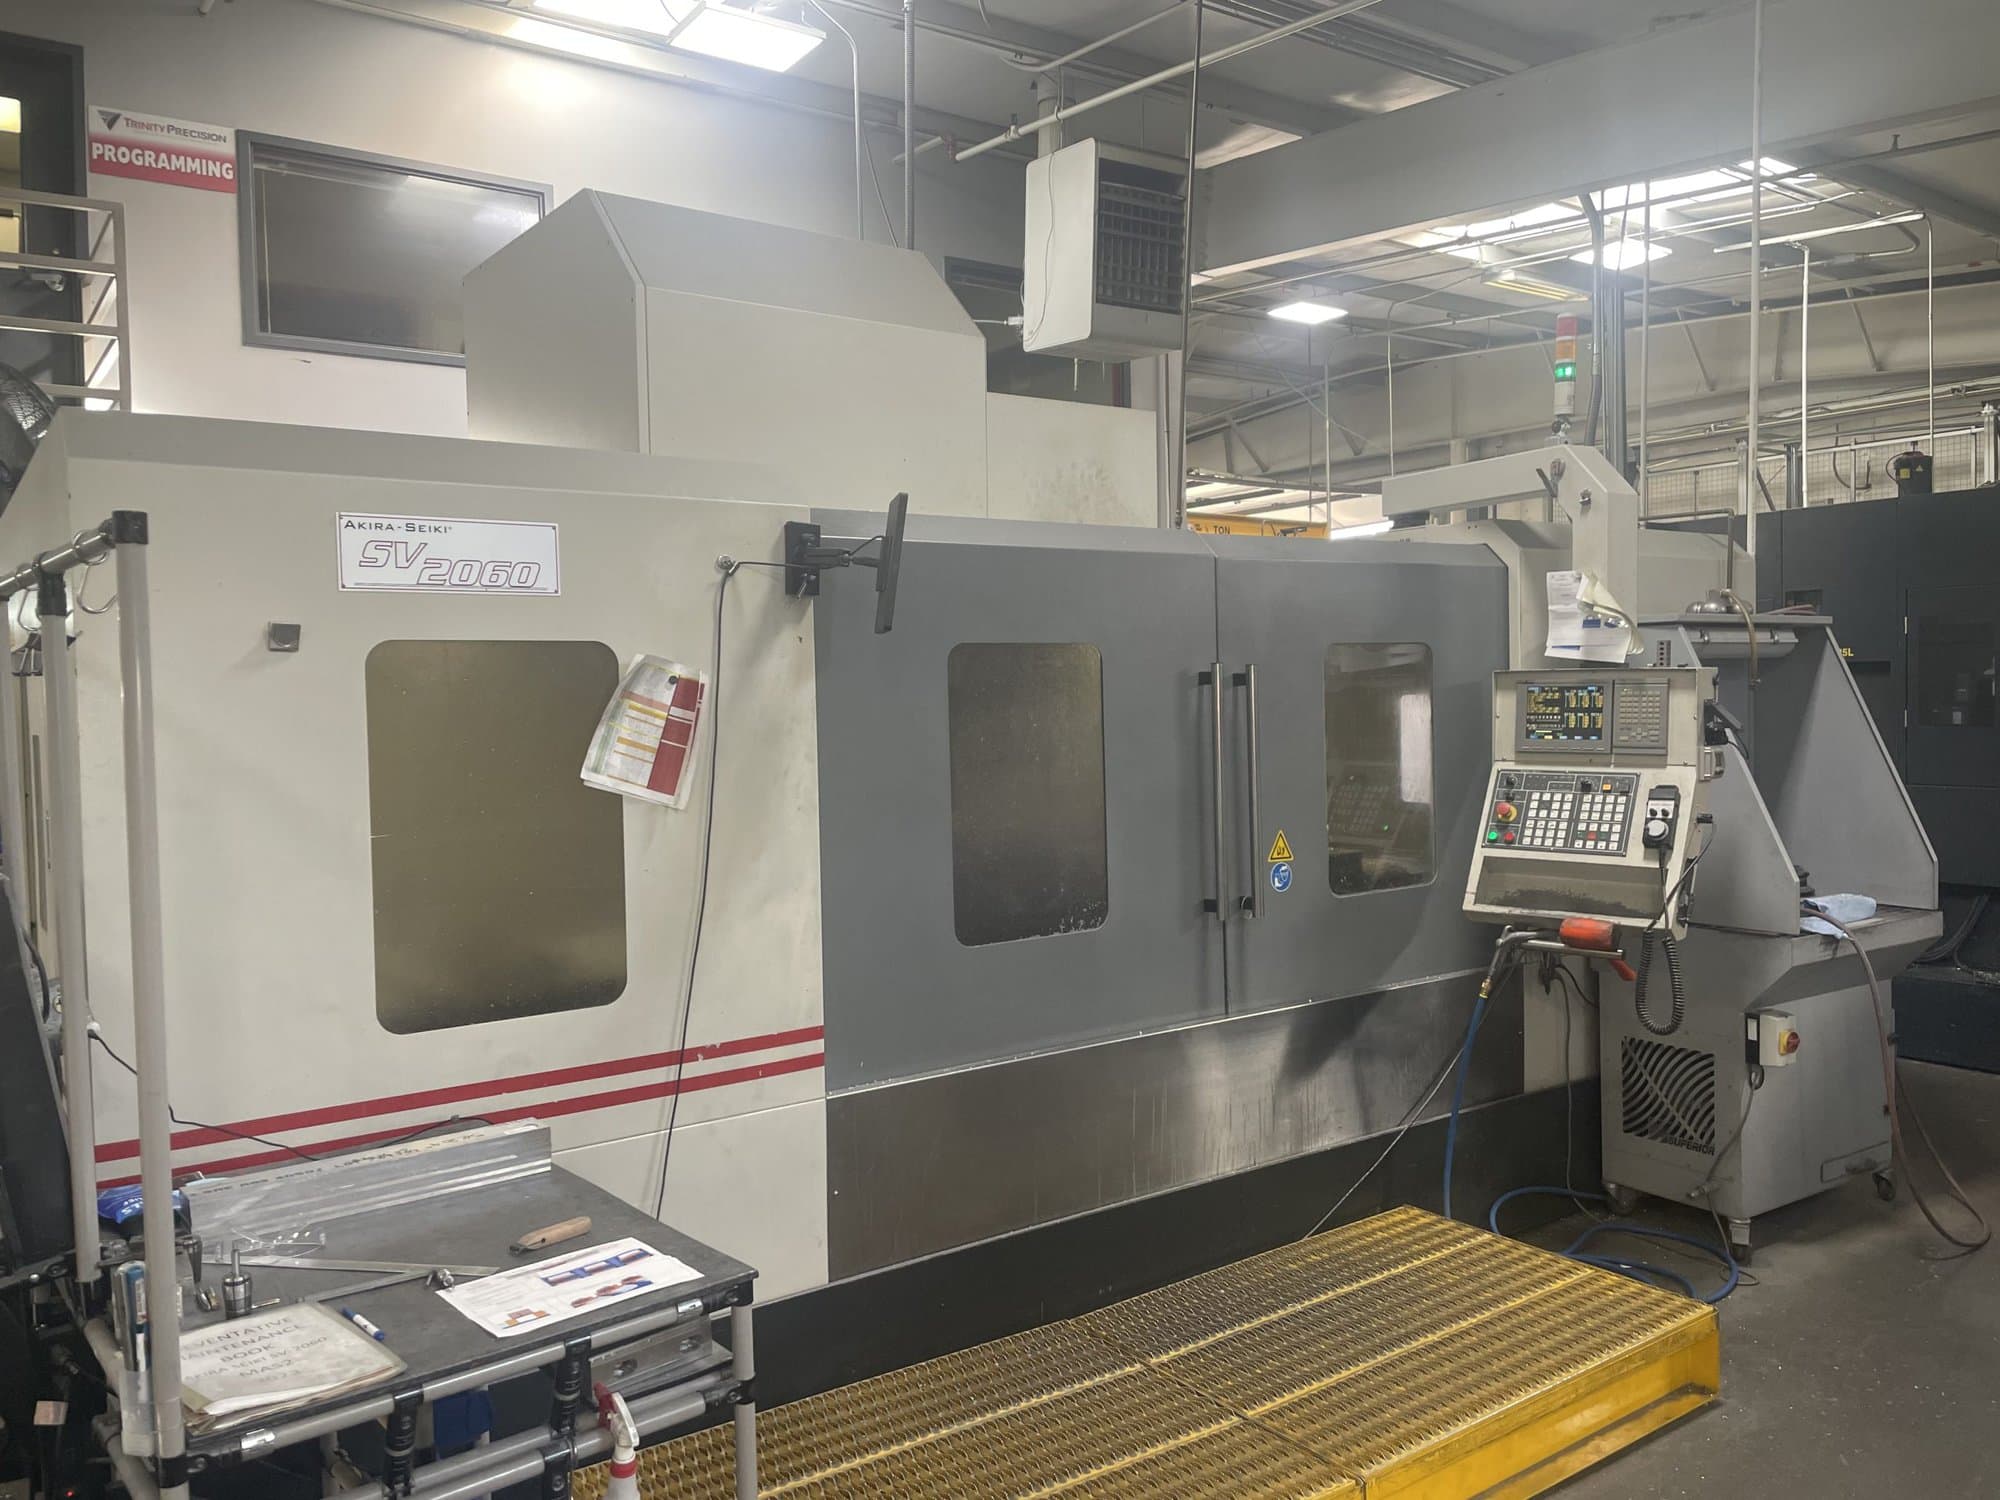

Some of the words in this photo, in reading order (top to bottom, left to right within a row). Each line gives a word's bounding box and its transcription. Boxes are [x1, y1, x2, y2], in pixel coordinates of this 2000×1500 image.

[124, 117, 165, 133] TRINITY
[167, 124, 227, 144] PRECISION
[91, 142, 234, 180] PROGRAMMING
[1213, 525, 1231, 535] TON
[183, 1318, 291, 1352] VENTATIVE
[220, 1343, 273, 1362] BOOK
